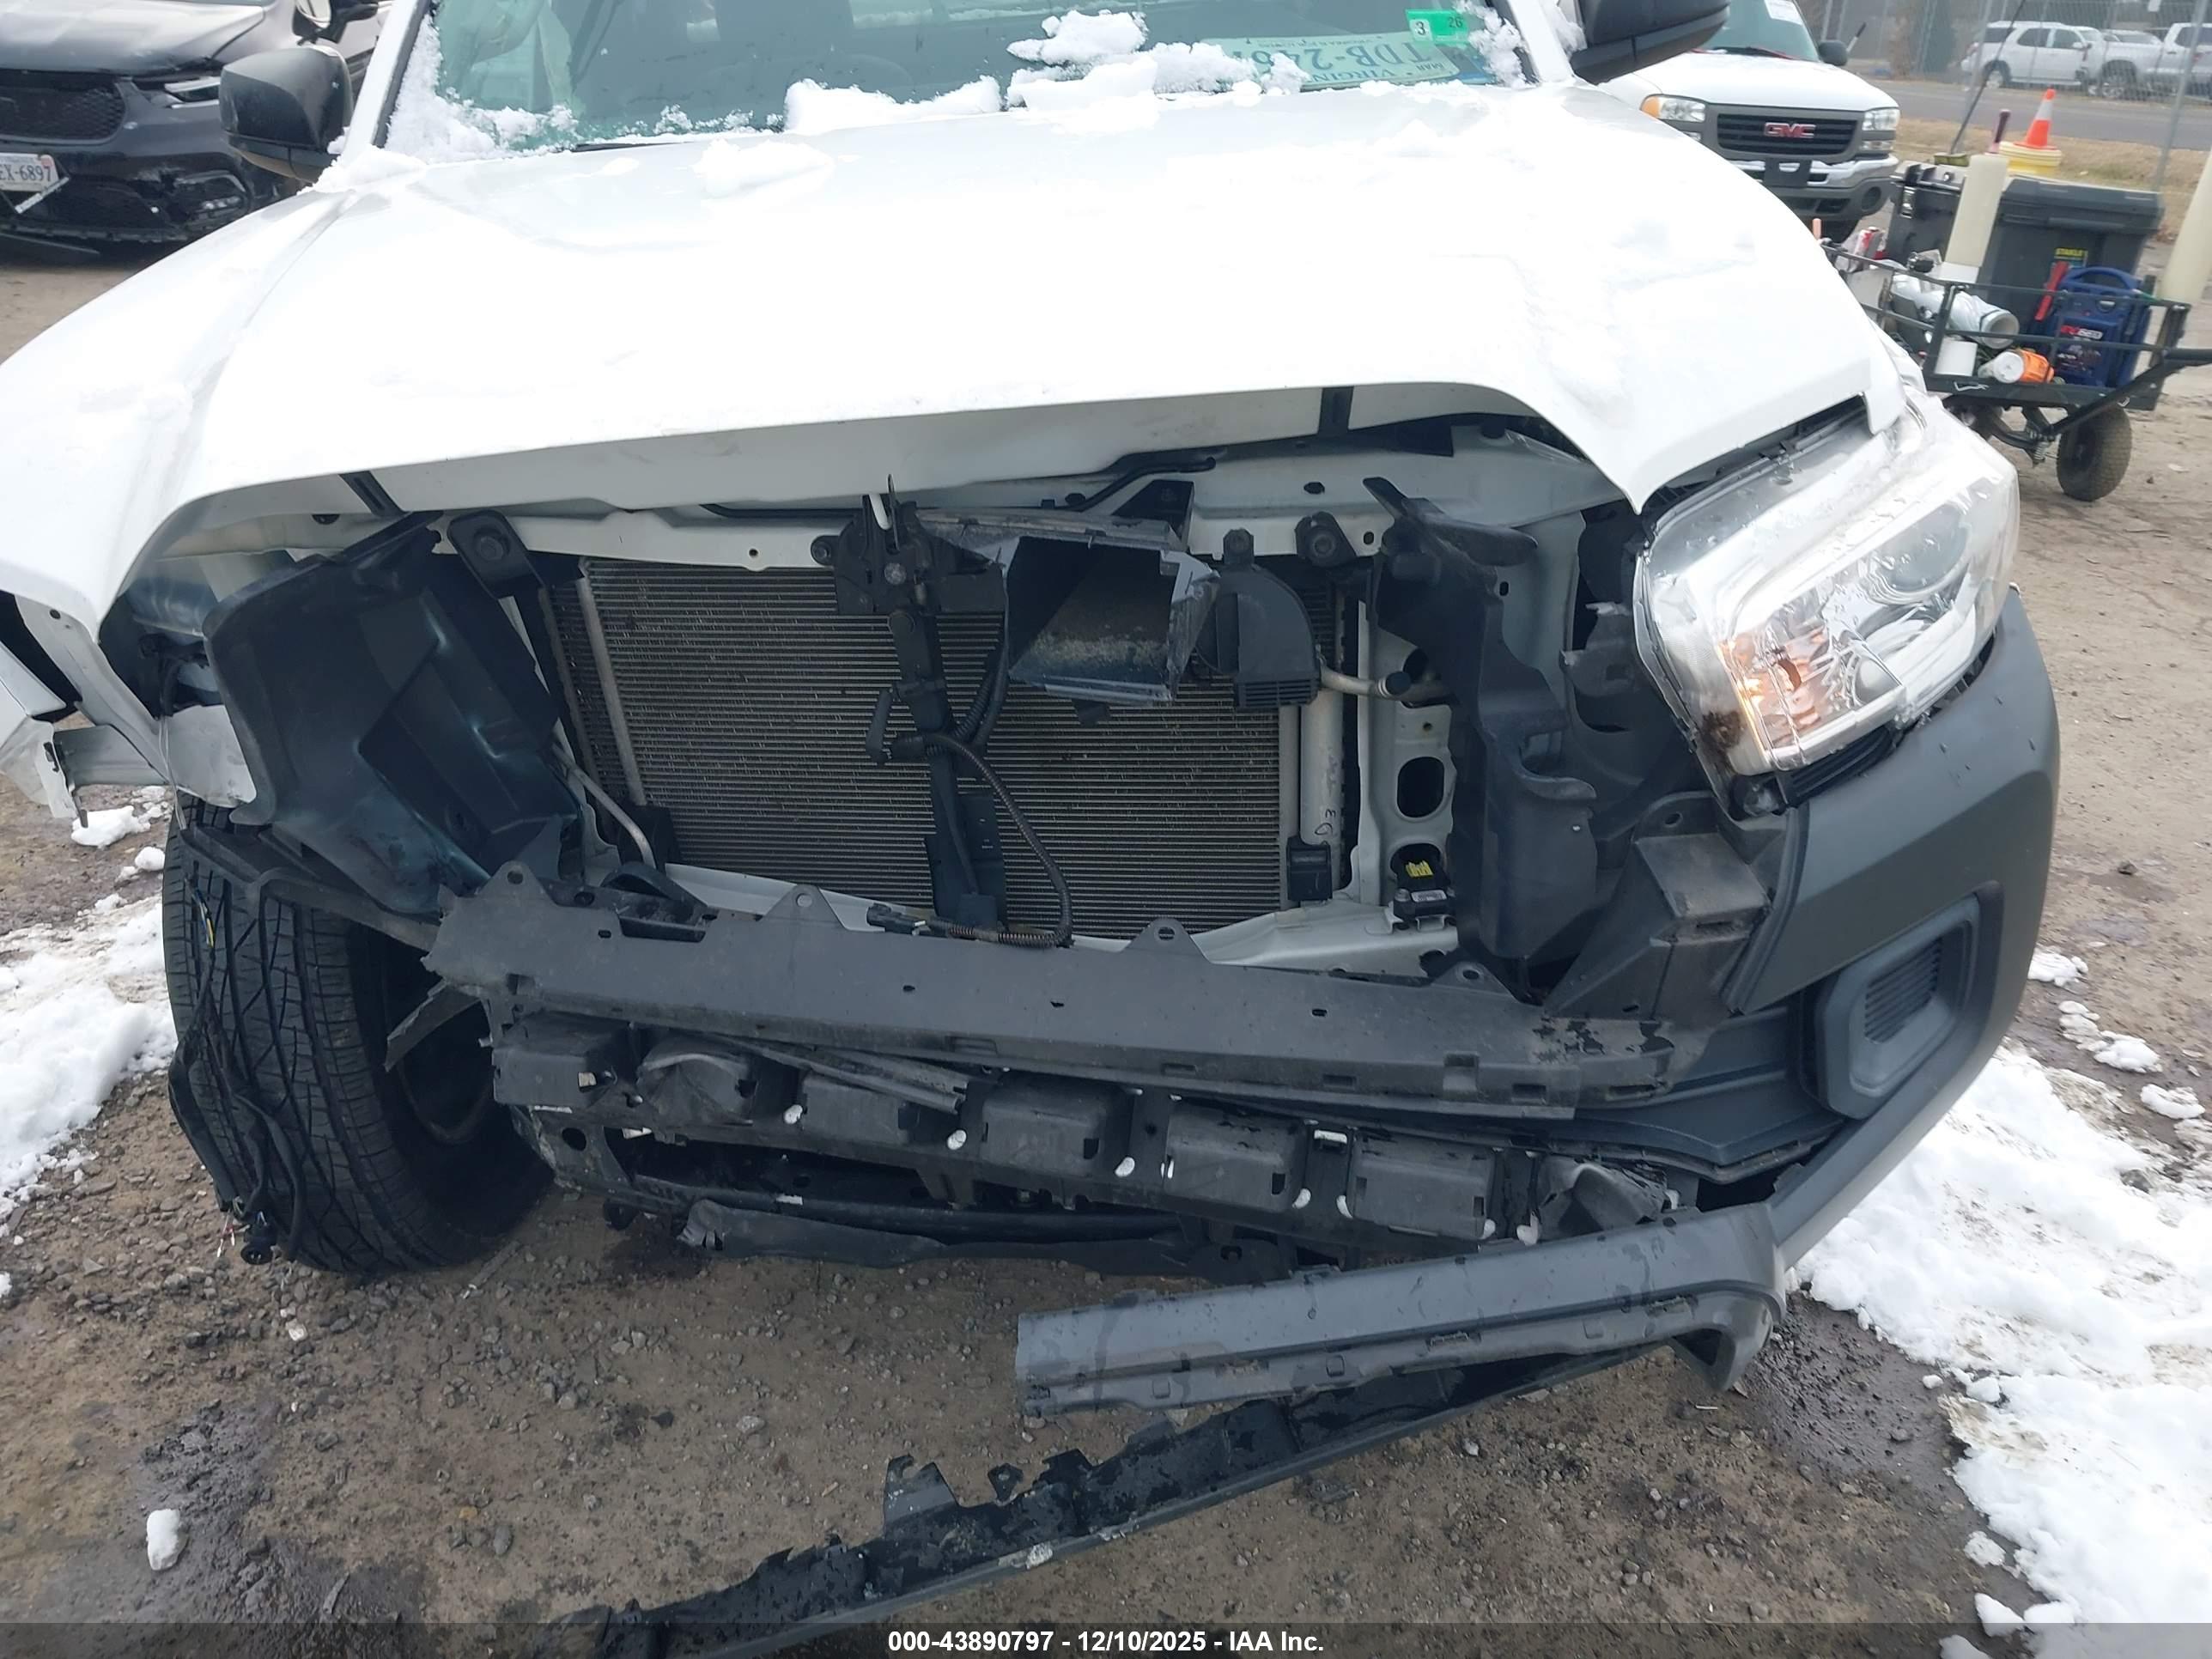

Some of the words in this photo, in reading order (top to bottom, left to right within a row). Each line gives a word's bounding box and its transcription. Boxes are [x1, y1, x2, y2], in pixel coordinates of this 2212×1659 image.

[1415, 21, 1425, 35] 3
[1448, 15, 1463, 28] 26
[1306, 68, 1396, 83] VIRGIN
[1765, 122, 1816, 138] GMC
